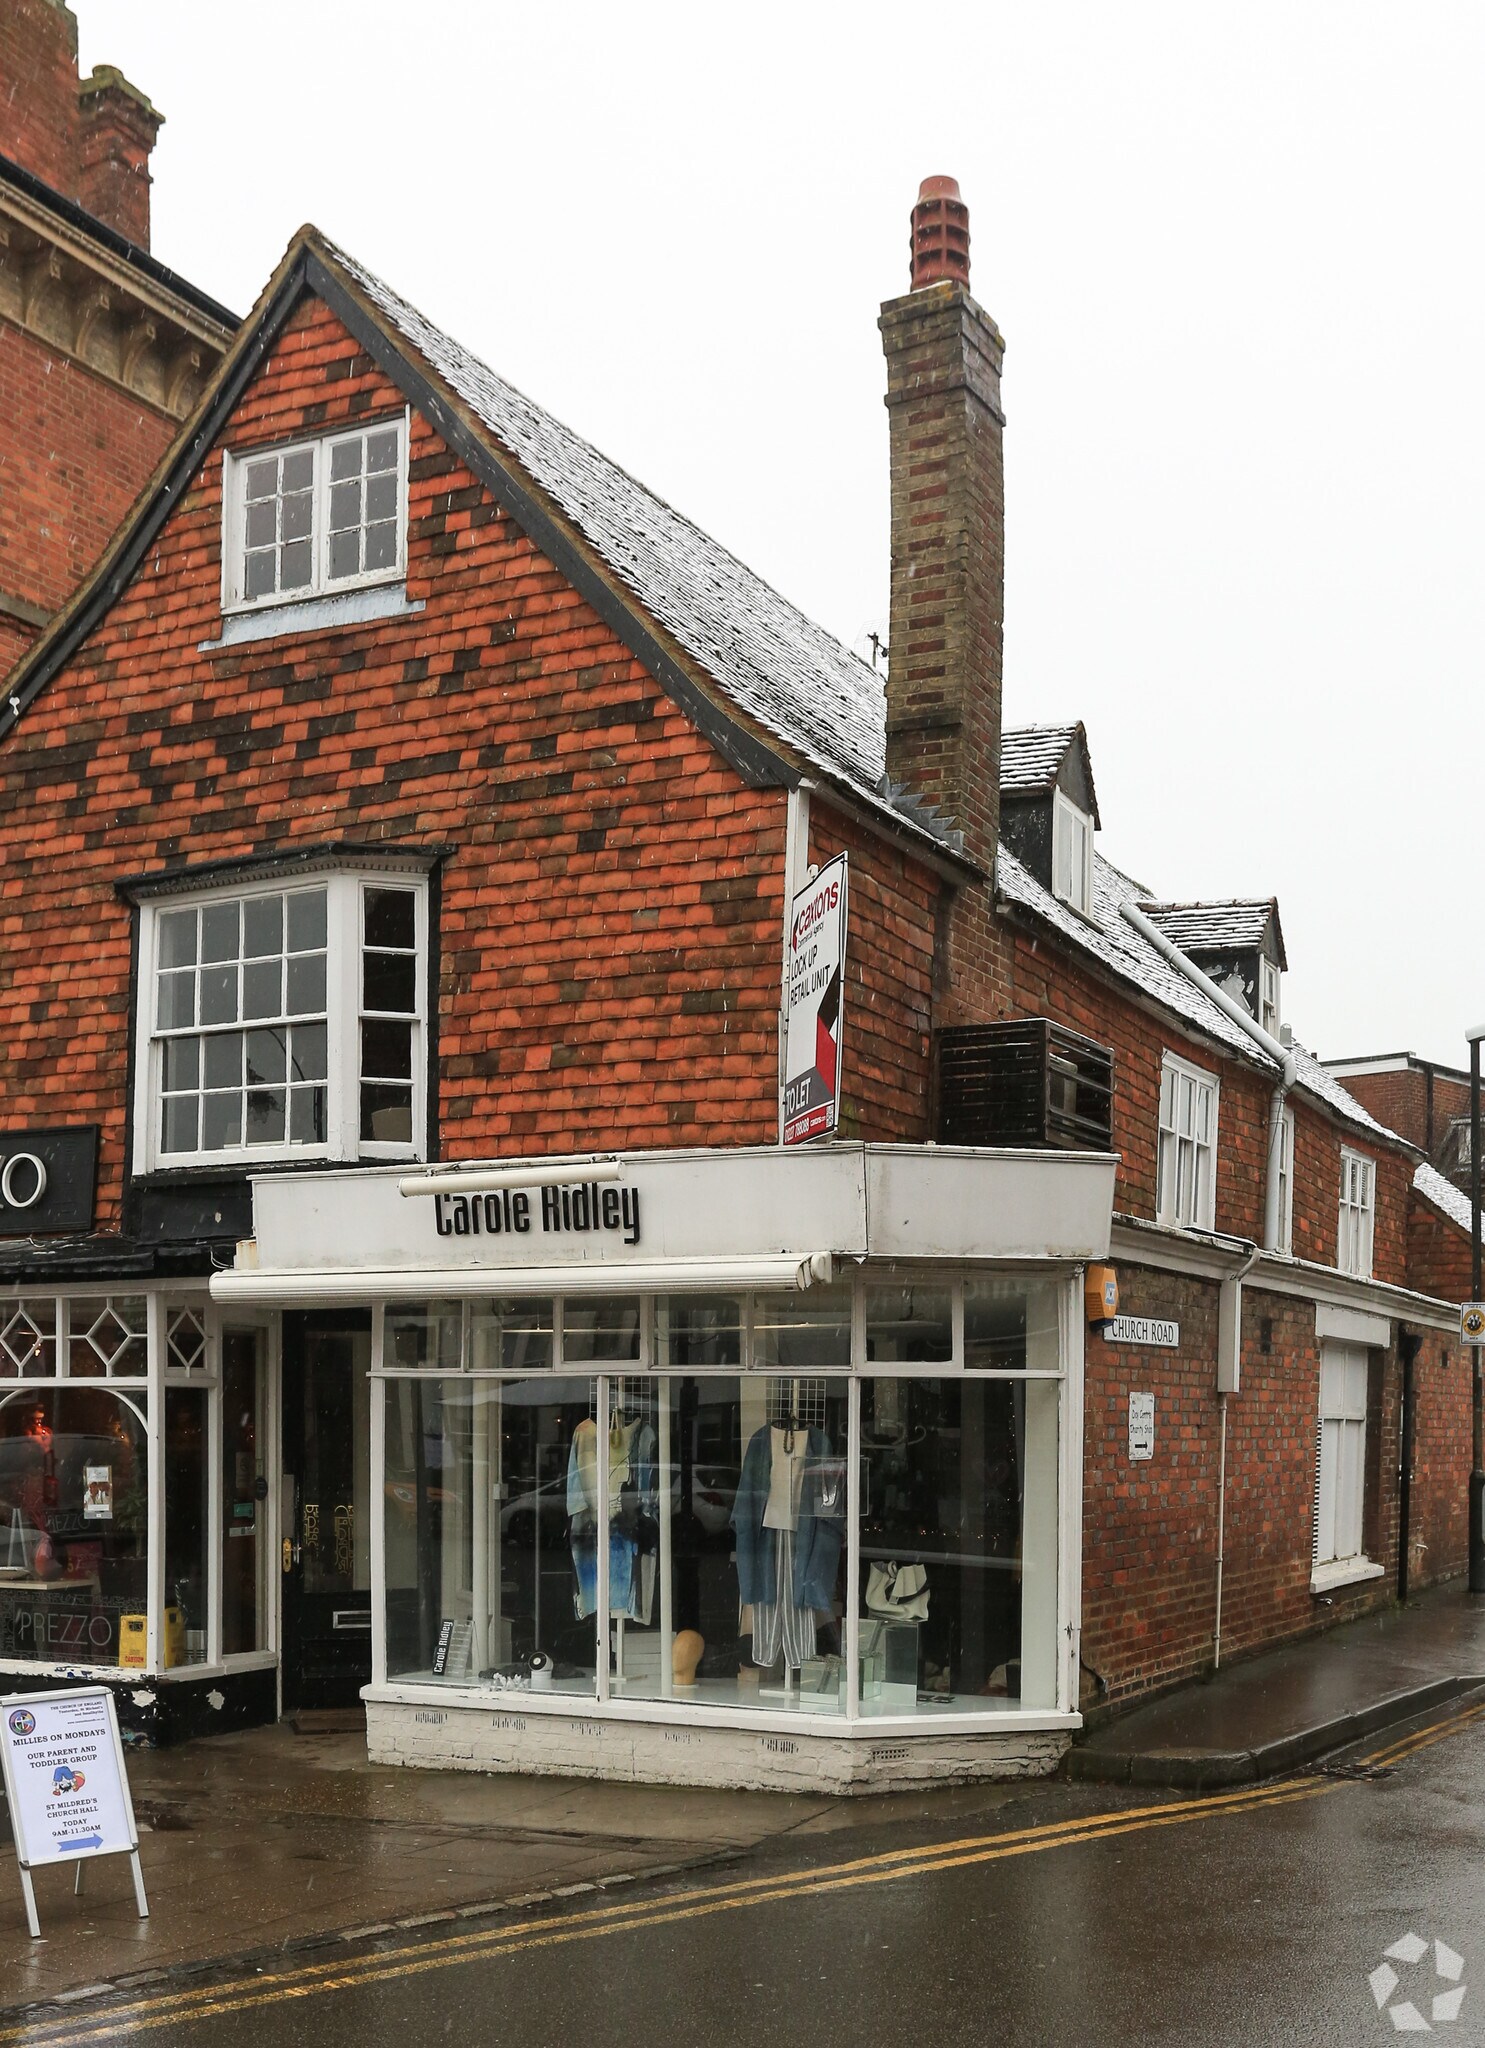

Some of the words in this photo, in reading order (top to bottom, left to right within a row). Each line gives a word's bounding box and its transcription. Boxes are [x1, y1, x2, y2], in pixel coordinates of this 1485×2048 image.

[799, 881, 839, 936] caxtons
[791, 951, 807, 981] LOCK
[808, 944, 818, 968] UP
[790, 977, 810, 1009] RETAIL
[812, 964, 830, 992] UNIT
[787, 1088, 796, 1115] TO
[796, 1077, 811, 1110] LET
[435, 1189, 530, 1236] Carole
[540, 1182, 641, 1246] Ridley
[1112, 1319, 1148, 1340] CHURCH
[1152, 1323, 1174, 1343] ROAD
[20, 1611, 112, 1646] PREZZO
[439, 1622, 453, 1645] Ridley
[434, 1647, 446, 1672] Carole
[13, 1736, 48, 1746] MILLIES
[66, 1729, 106, 1739] MONDAYS
[30, 1758, 68, 1768] TODDLER
[70, 1754, 97, 1763] GROUP
[48, 1748, 78, 1757] PARENT
[47, 1809, 78, 1818] CHURCH
[58, 1798, 97, 1808] MILDRED'S
[52, 1825, 101, 1836] 9AM-11.30AM
